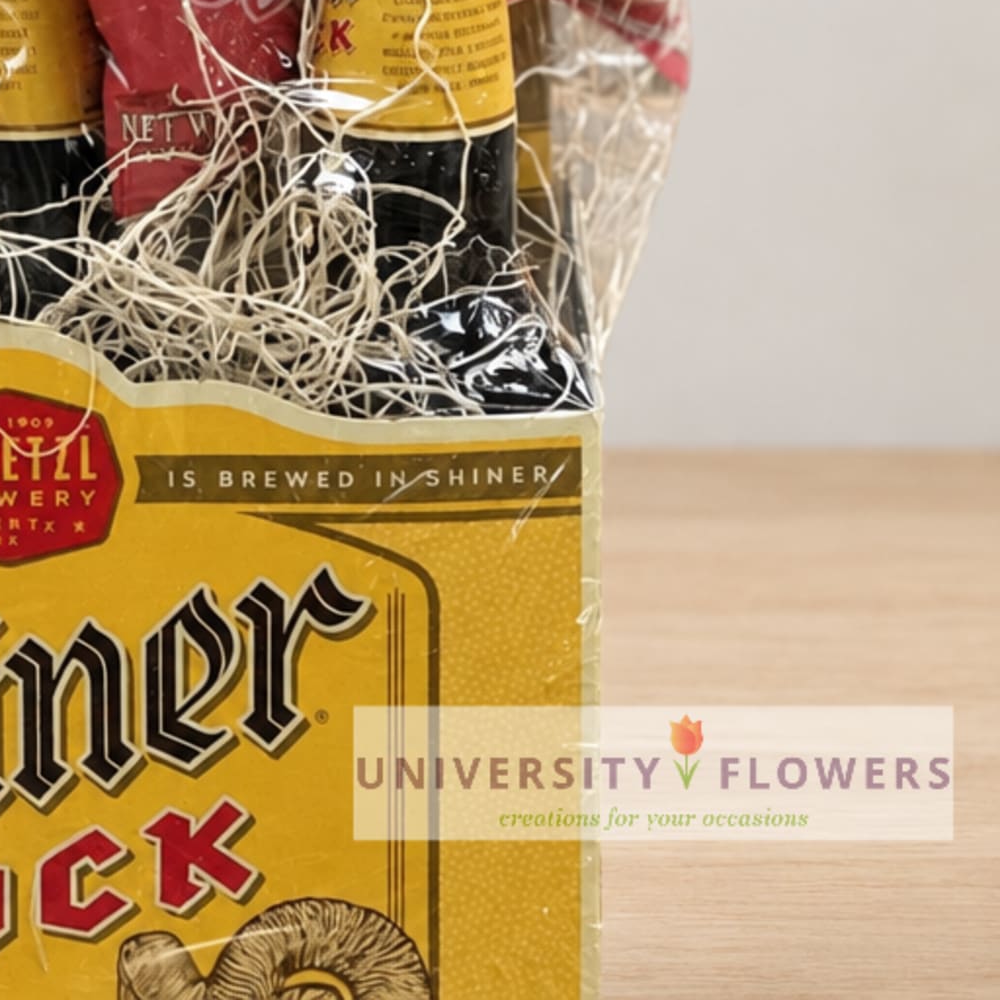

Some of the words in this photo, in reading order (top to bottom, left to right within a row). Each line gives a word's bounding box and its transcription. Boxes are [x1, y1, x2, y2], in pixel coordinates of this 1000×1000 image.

[121, 111, 173, 143] NET
[168, 469, 197, 488] IS
[218, 470, 356, 489] BREWED
[375, 471, 406, 488] IN
[424, 465, 550, 488] SHINER
